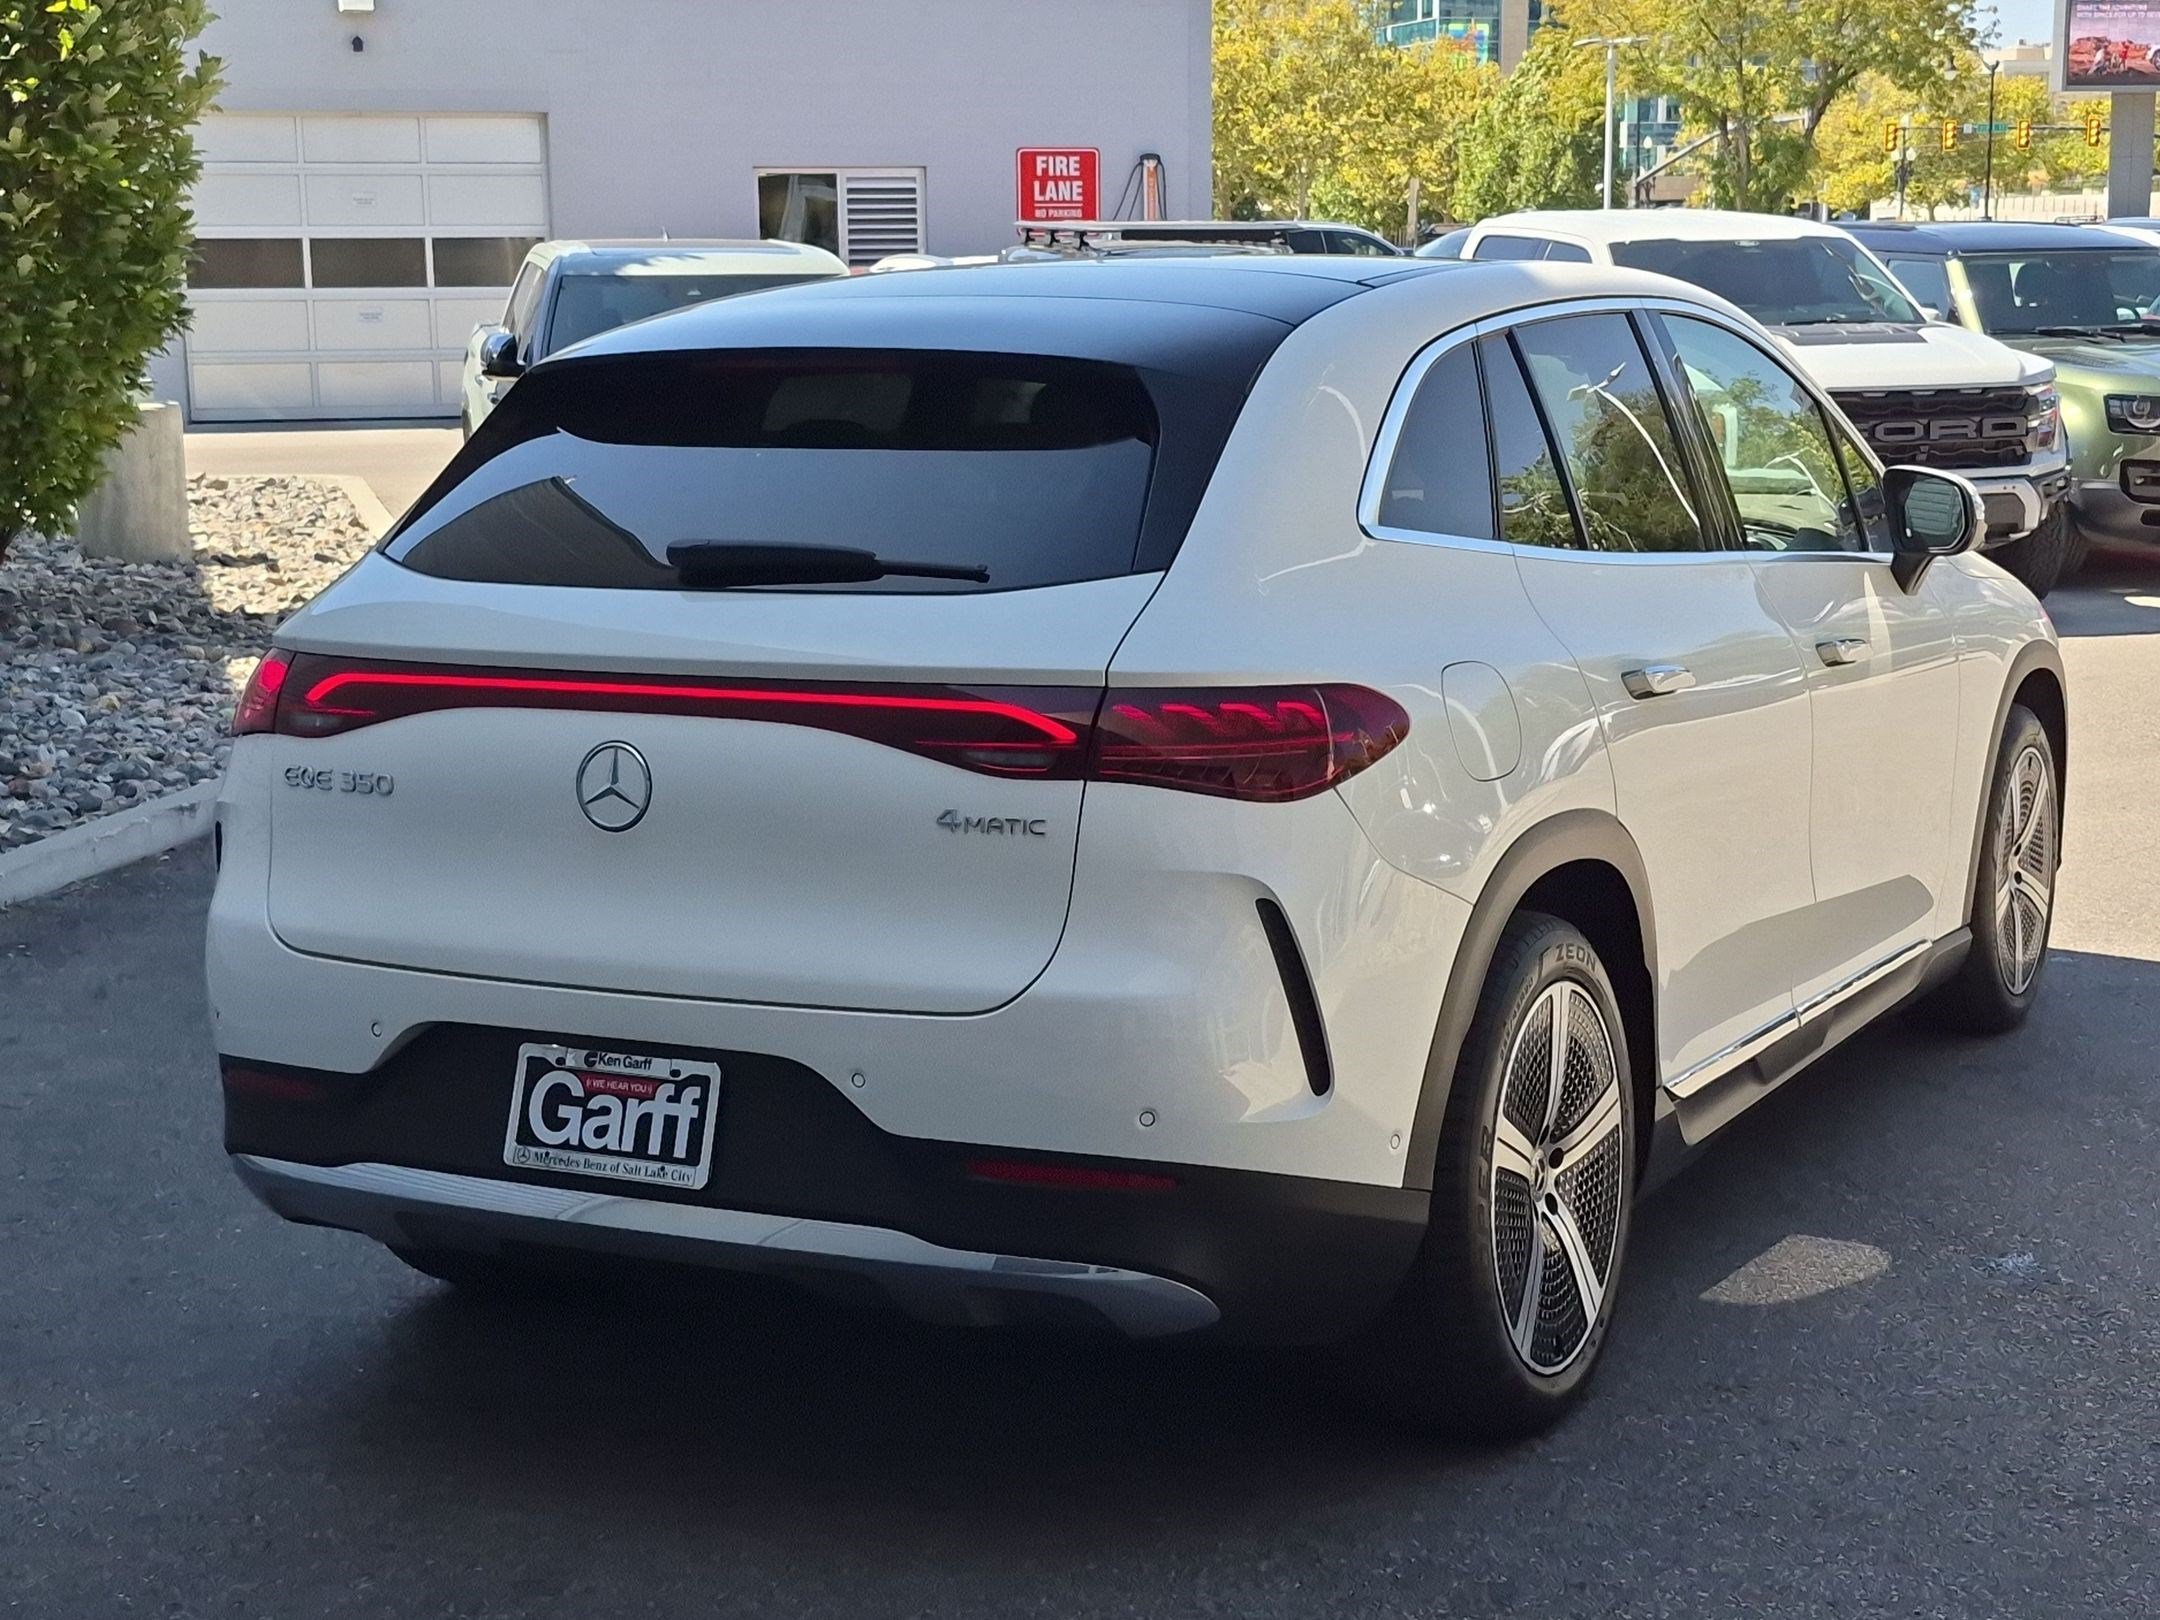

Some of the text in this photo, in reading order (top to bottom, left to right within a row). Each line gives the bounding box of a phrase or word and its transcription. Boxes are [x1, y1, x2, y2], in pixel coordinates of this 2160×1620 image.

[1036, 155, 1081, 177] FIRE
[1033, 180, 1084, 202] LANE
[1034, 208, 1083, 219] NO PARKING
[1857, 415, 2028, 443] ORD
[284, 765, 395, 796] EQE 350
[936, 808, 1047, 836] 4MATIC
[1555, 943, 1597, 973] ZEON
[598, 1051, 653, 1071] Ken Garff
[592, 1078, 647, 1093] WE HEAR YOU
[528, 1070, 701, 1159] Garff
[533, 1150, 693, 1183] Mercedes Benz of Salt Lake City
